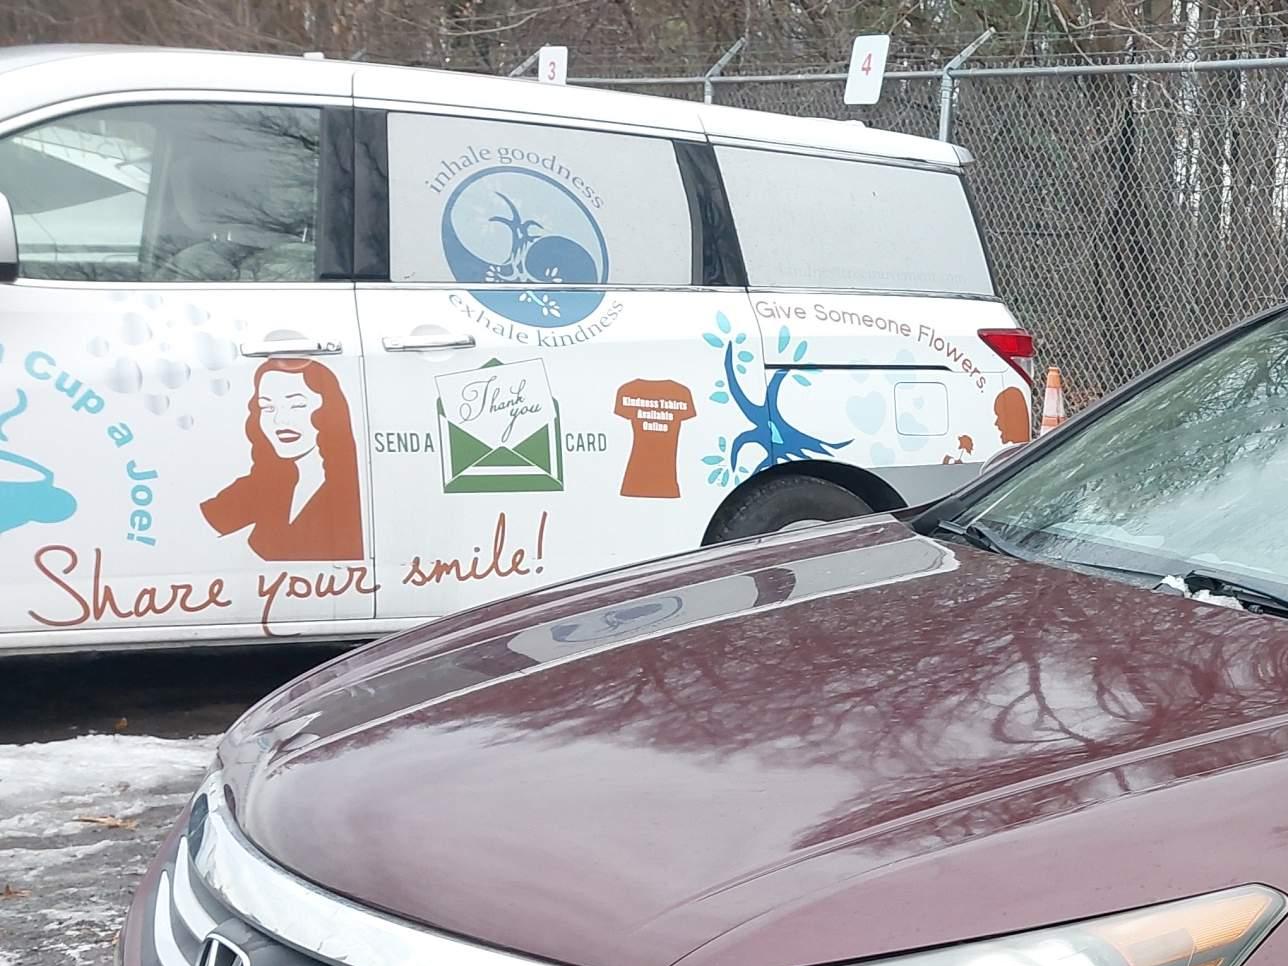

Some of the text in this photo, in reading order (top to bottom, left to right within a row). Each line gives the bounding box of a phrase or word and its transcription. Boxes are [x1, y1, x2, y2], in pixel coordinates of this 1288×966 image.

[547, 61, 556, 80] 3
[861, 53, 872, 75] 4
[425, 145, 604, 209] inhale goodness
[448, 294, 624, 347] exhale kindness
[755, 300, 988, 393] Give Someone Flowers.
[458, 375, 526, 424] Thank
[622, 396, 688, 411] Kindness Tshirts
[637, 409, 673, 421] Available
[374, 432, 607, 453] SEND A CARD
[501, 403, 541, 443] you
[642, 421, 669, 432] Online
[24, 350, 158, 546] Cup a Joe!
[28, 511, 548, 638] Share your smile!
